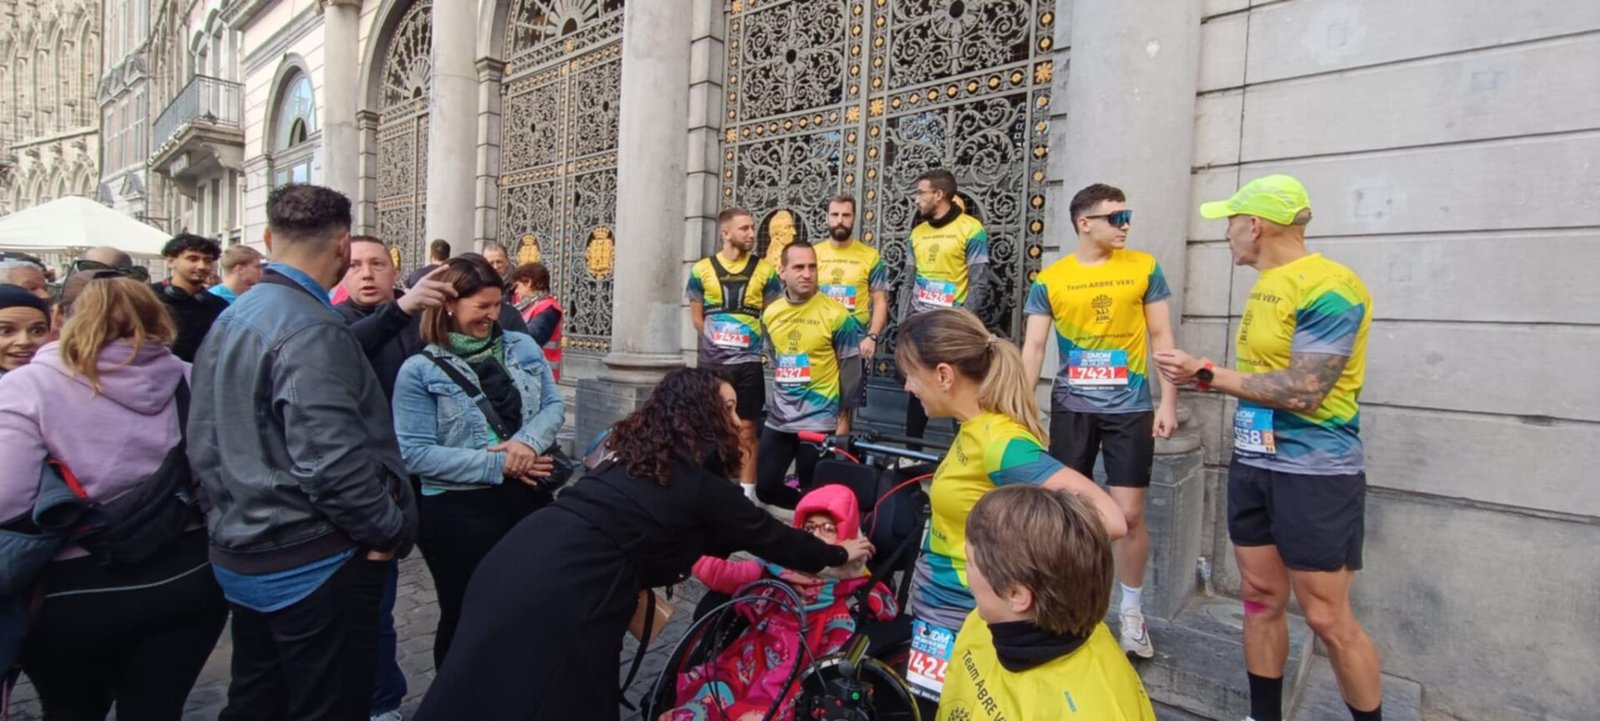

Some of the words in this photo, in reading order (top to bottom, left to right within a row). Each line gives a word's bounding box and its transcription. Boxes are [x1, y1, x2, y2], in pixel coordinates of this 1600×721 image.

[1089, 281, 1114, 289] ARBRE
[1078, 366, 1115, 379] 7421
[962, 648, 980, 681] Team
[975, 679, 998, 716] ABRE
